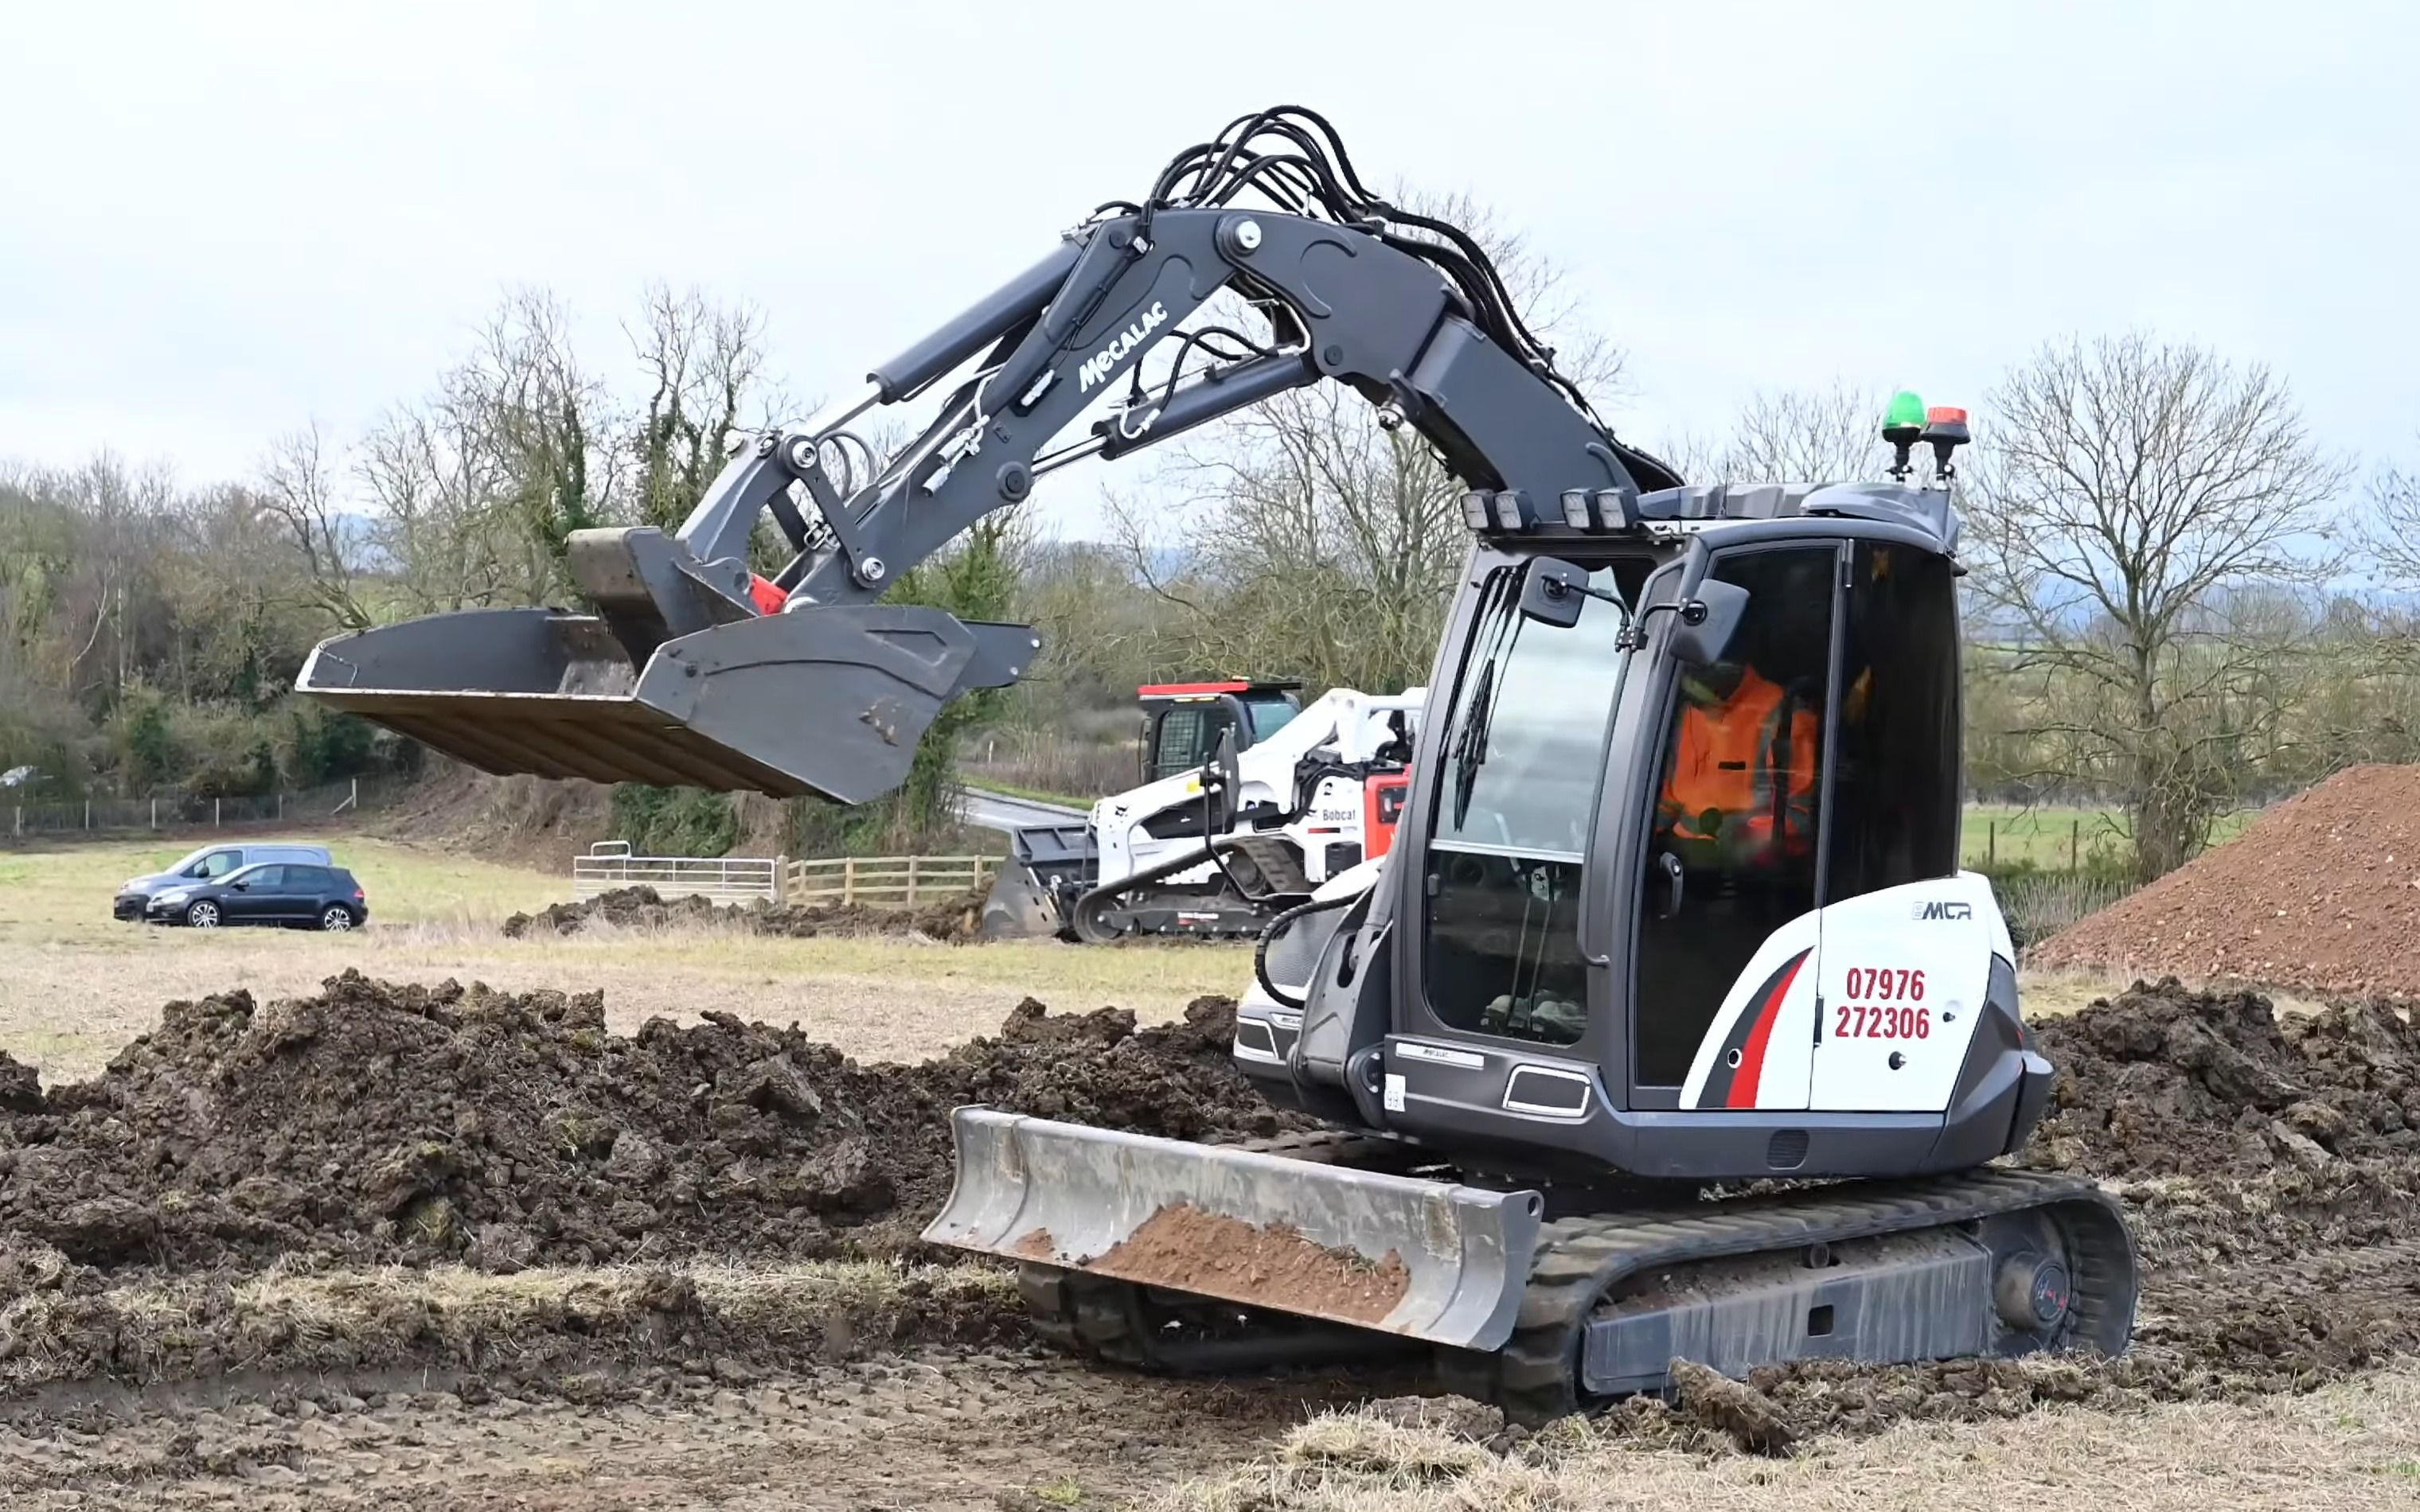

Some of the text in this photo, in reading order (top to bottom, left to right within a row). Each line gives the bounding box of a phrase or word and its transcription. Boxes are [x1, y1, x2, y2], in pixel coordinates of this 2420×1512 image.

[1323, 809, 1356, 821] Bobcat
[1847, 968, 1925, 1000] 07976
[1835, 1006, 1930, 1039] 272306
